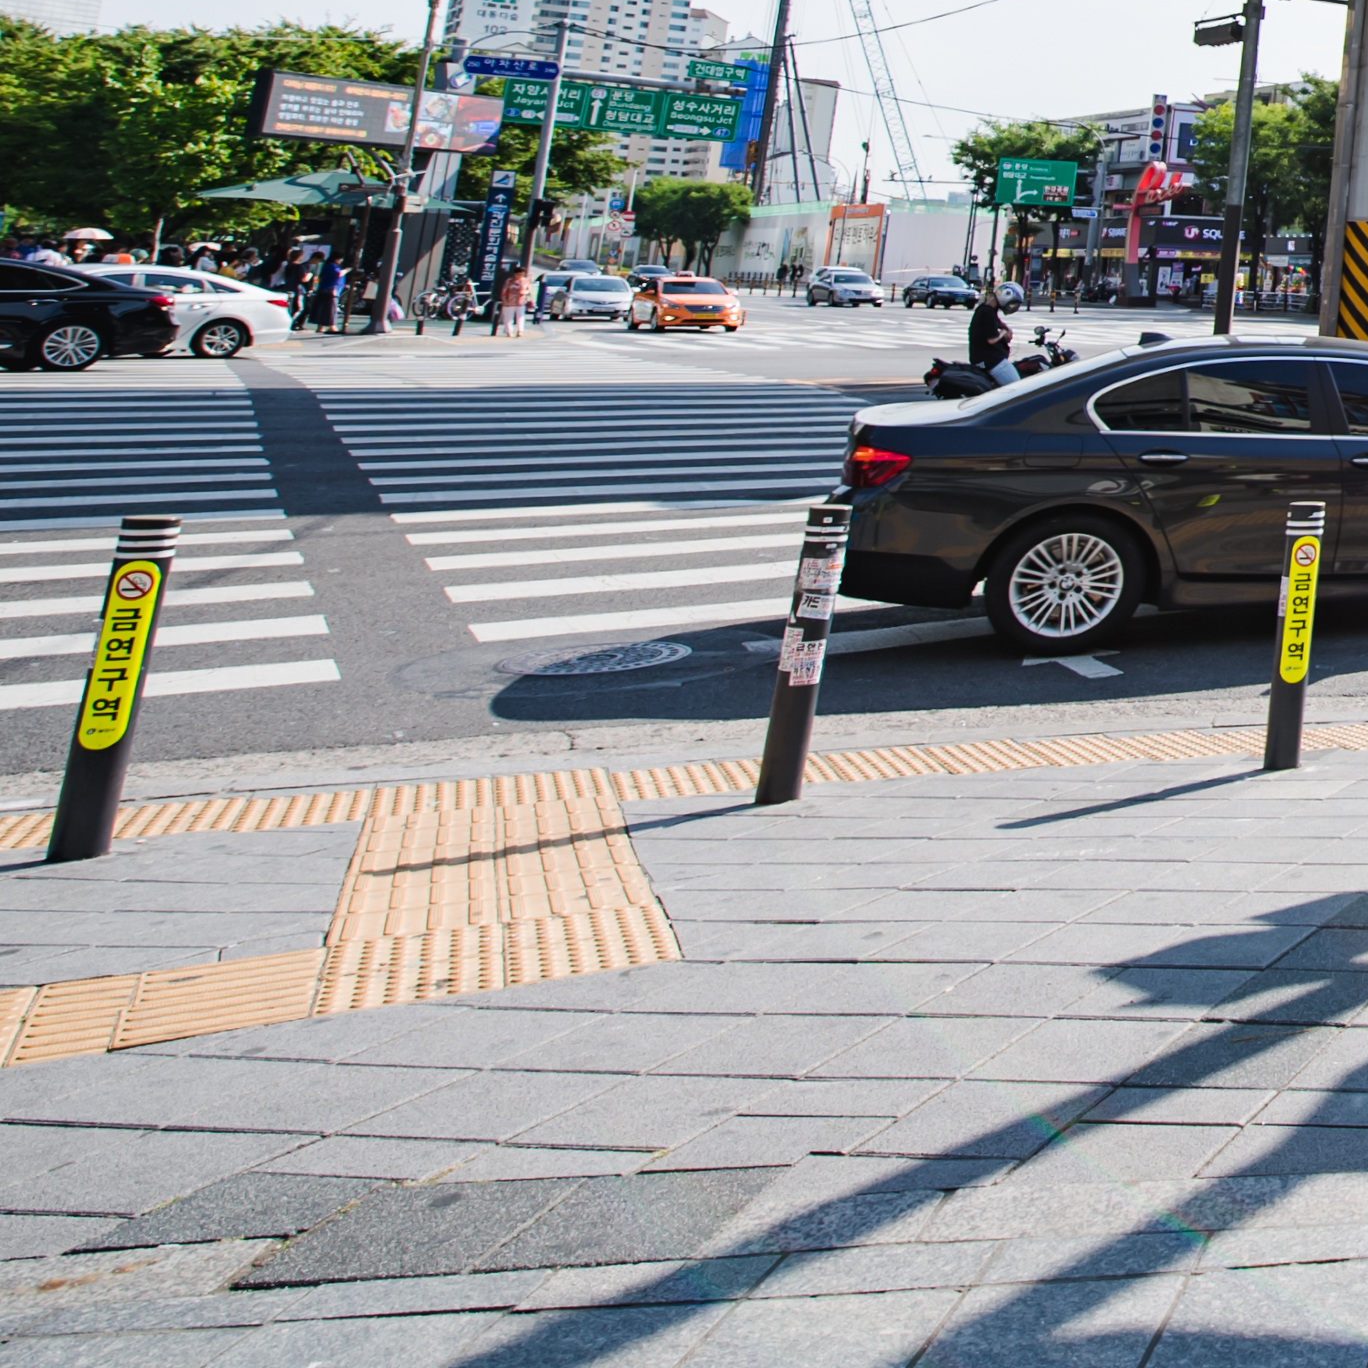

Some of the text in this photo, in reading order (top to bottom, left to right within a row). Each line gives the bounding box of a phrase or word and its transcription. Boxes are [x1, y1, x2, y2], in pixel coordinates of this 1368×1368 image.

[483, 58, 539, 71] 아차산로
[694, 63, 746, 80] 건대입구역
[672, 99, 737, 116] 성수사거리
[605, 110, 655, 124] 청담대교
[670, 112, 734, 125] Seongsu Jct
[1287, 572, 1312, 661] 금연구역
[91, 607, 143, 722] 금연구역
